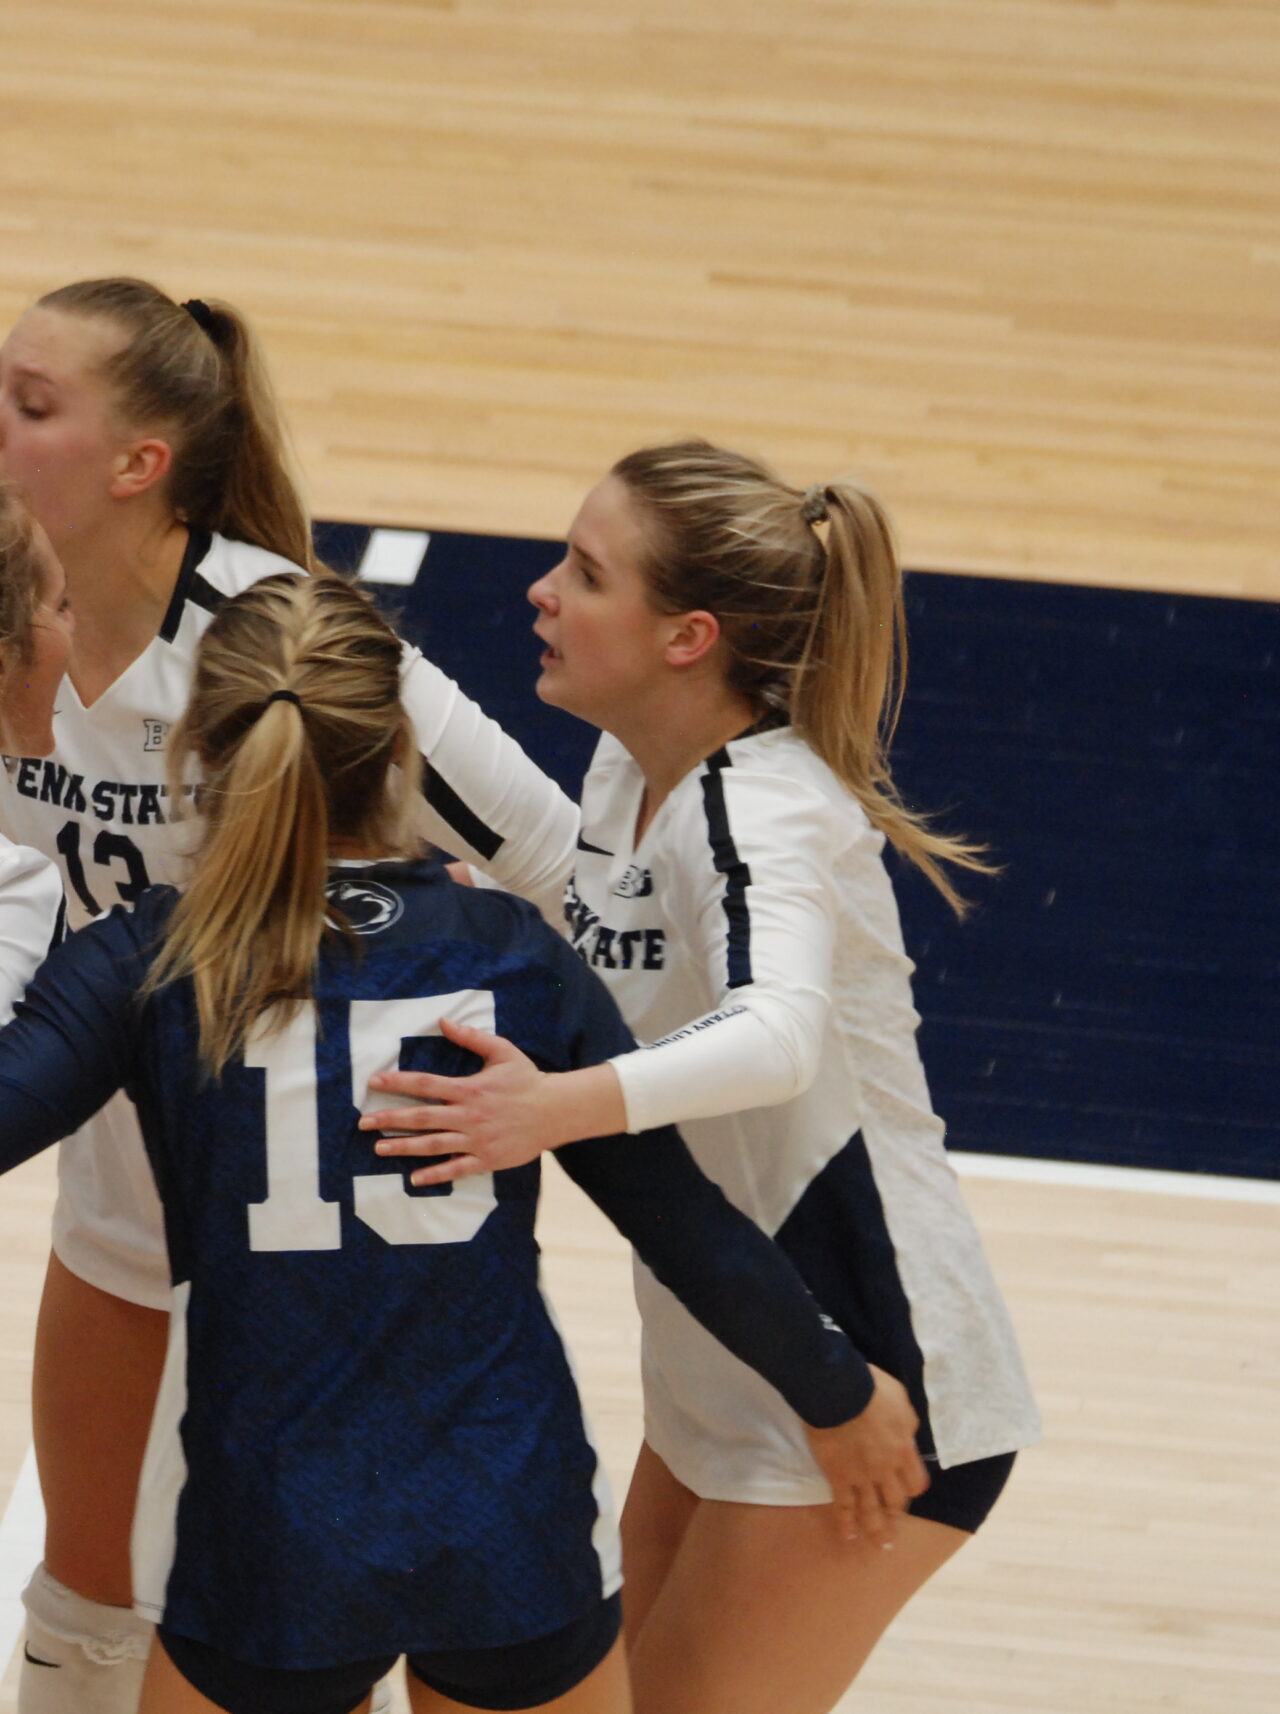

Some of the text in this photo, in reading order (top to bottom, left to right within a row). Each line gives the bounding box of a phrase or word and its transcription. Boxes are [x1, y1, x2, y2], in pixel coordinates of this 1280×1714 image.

[92, 780, 200, 825] STA
[56, 822, 150, 917] 13
[577, 925, 666, 970] ATE
[244, 989, 498, 1252] 15
